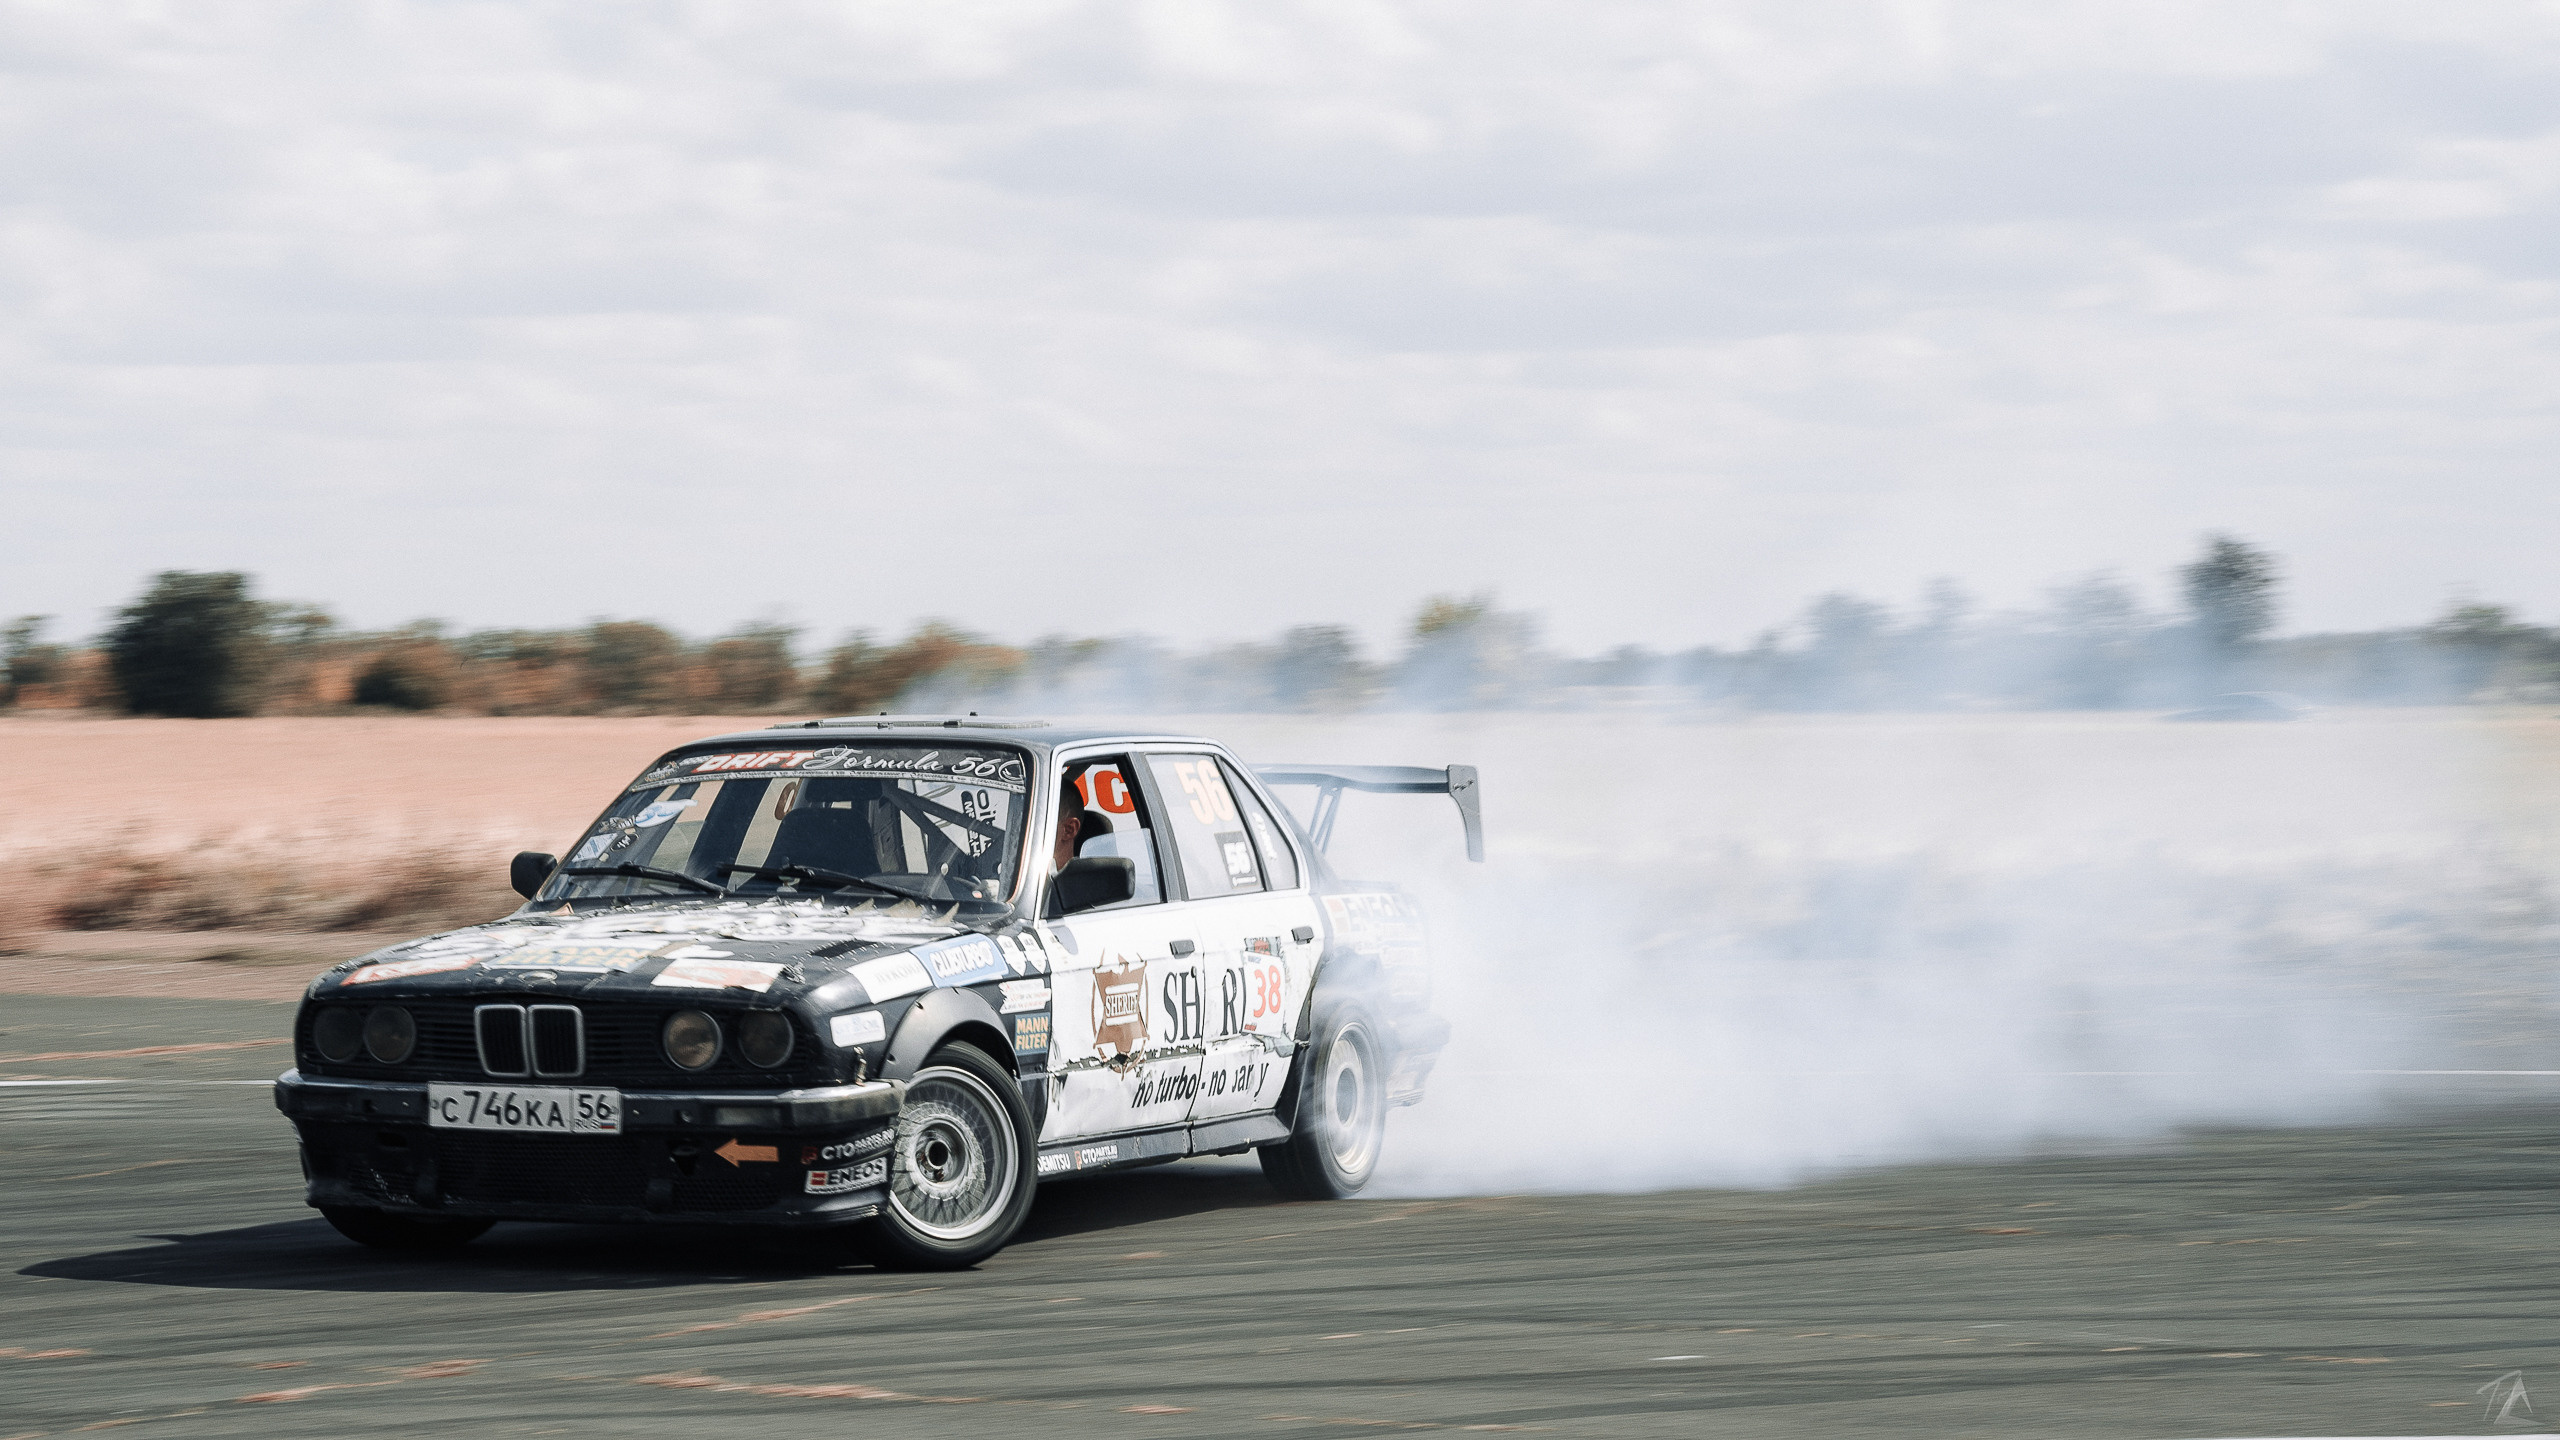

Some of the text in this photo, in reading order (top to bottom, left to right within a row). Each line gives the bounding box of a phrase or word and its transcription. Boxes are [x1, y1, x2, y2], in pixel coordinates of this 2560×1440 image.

[693, 751, 815, 773] DRIFT
[802, 745, 944, 770] Formula
[1173, 759, 1235, 825] 56
[1253, 965, 1282, 1018] 38
[1016, 1017, 1049, 1034] MANN
[1015, 1033, 1048, 1051] FILTER
[1131, 1080, 1154, 1108] no
[1154, 1066, 1197, 1104] turbo
[1208, 1069, 1227, 1097] no
[577, 1093, 613, 1119] 56
[827, 1159, 884, 1185] ENEOS
